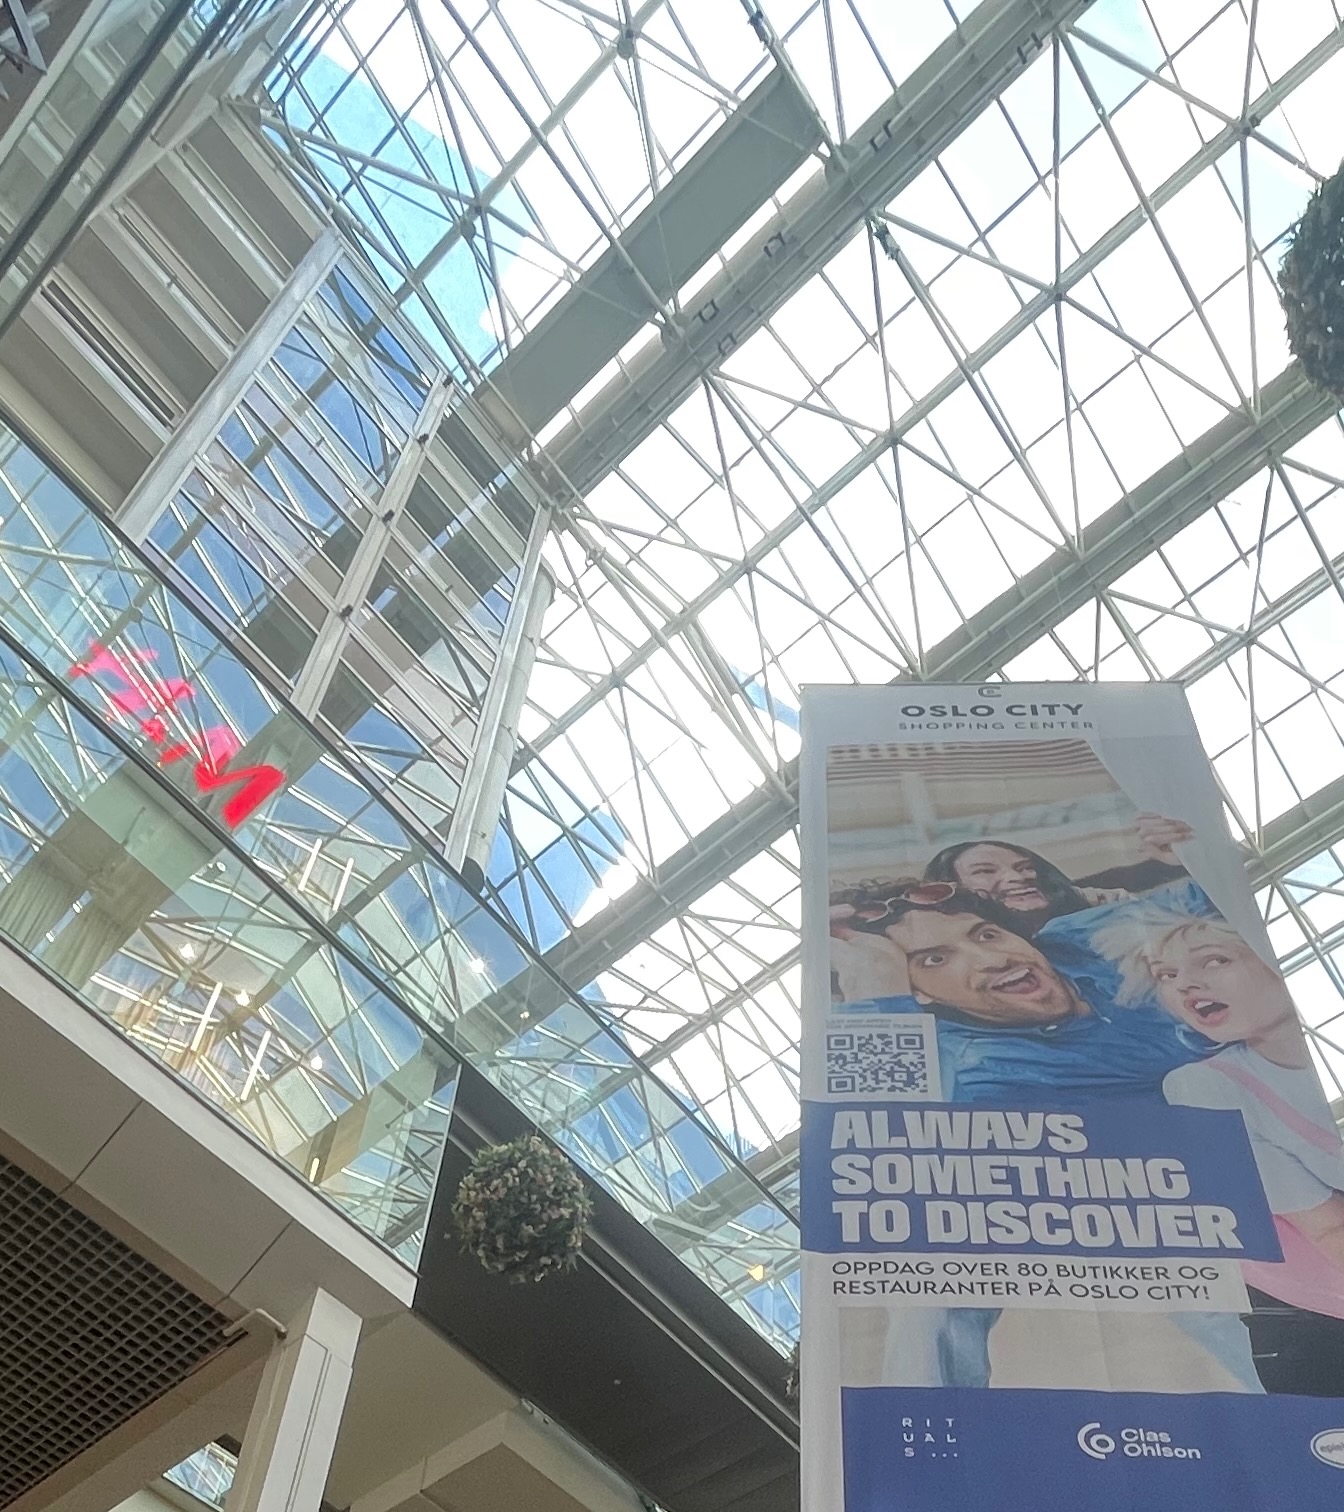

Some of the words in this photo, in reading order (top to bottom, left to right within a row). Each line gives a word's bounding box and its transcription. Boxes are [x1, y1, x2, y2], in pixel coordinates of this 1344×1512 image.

[900, 704, 995, 717] OSLO
[1005, 703, 1084, 717] CITY
[898, 721, 1005, 730] SHOPPING
[1014, 720, 1094, 730] CENTER
[830, 1110, 1089, 1153] ALWAYS
[830, 1154, 1191, 1200] SOMETHING
[831, 1200, 911, 1244] TO
[925, 1202, 1245, 1250] DISCOVER
[831, 1260, 935, 1277] OPPDAG
[942, 1261, 1009, 1277] OVER
[1017, 1262, 1048, 1277] 80
[1056, 1264, 1170, 1281] BUTIKKER
[1177, 1265, 1220, 1281] OG
[831, 1279, 1020, 1297] RESTAURANTER
[1028, 1278, 1060, 1298] PÅ
[1068, 1284, 1139, 1299] OSLO
[1146, 1284, 1210, 1300] CITY!
[1120, 1428, 1171, 1443] Clas
[1122, 1443, 1202, 1460] Ohlson
